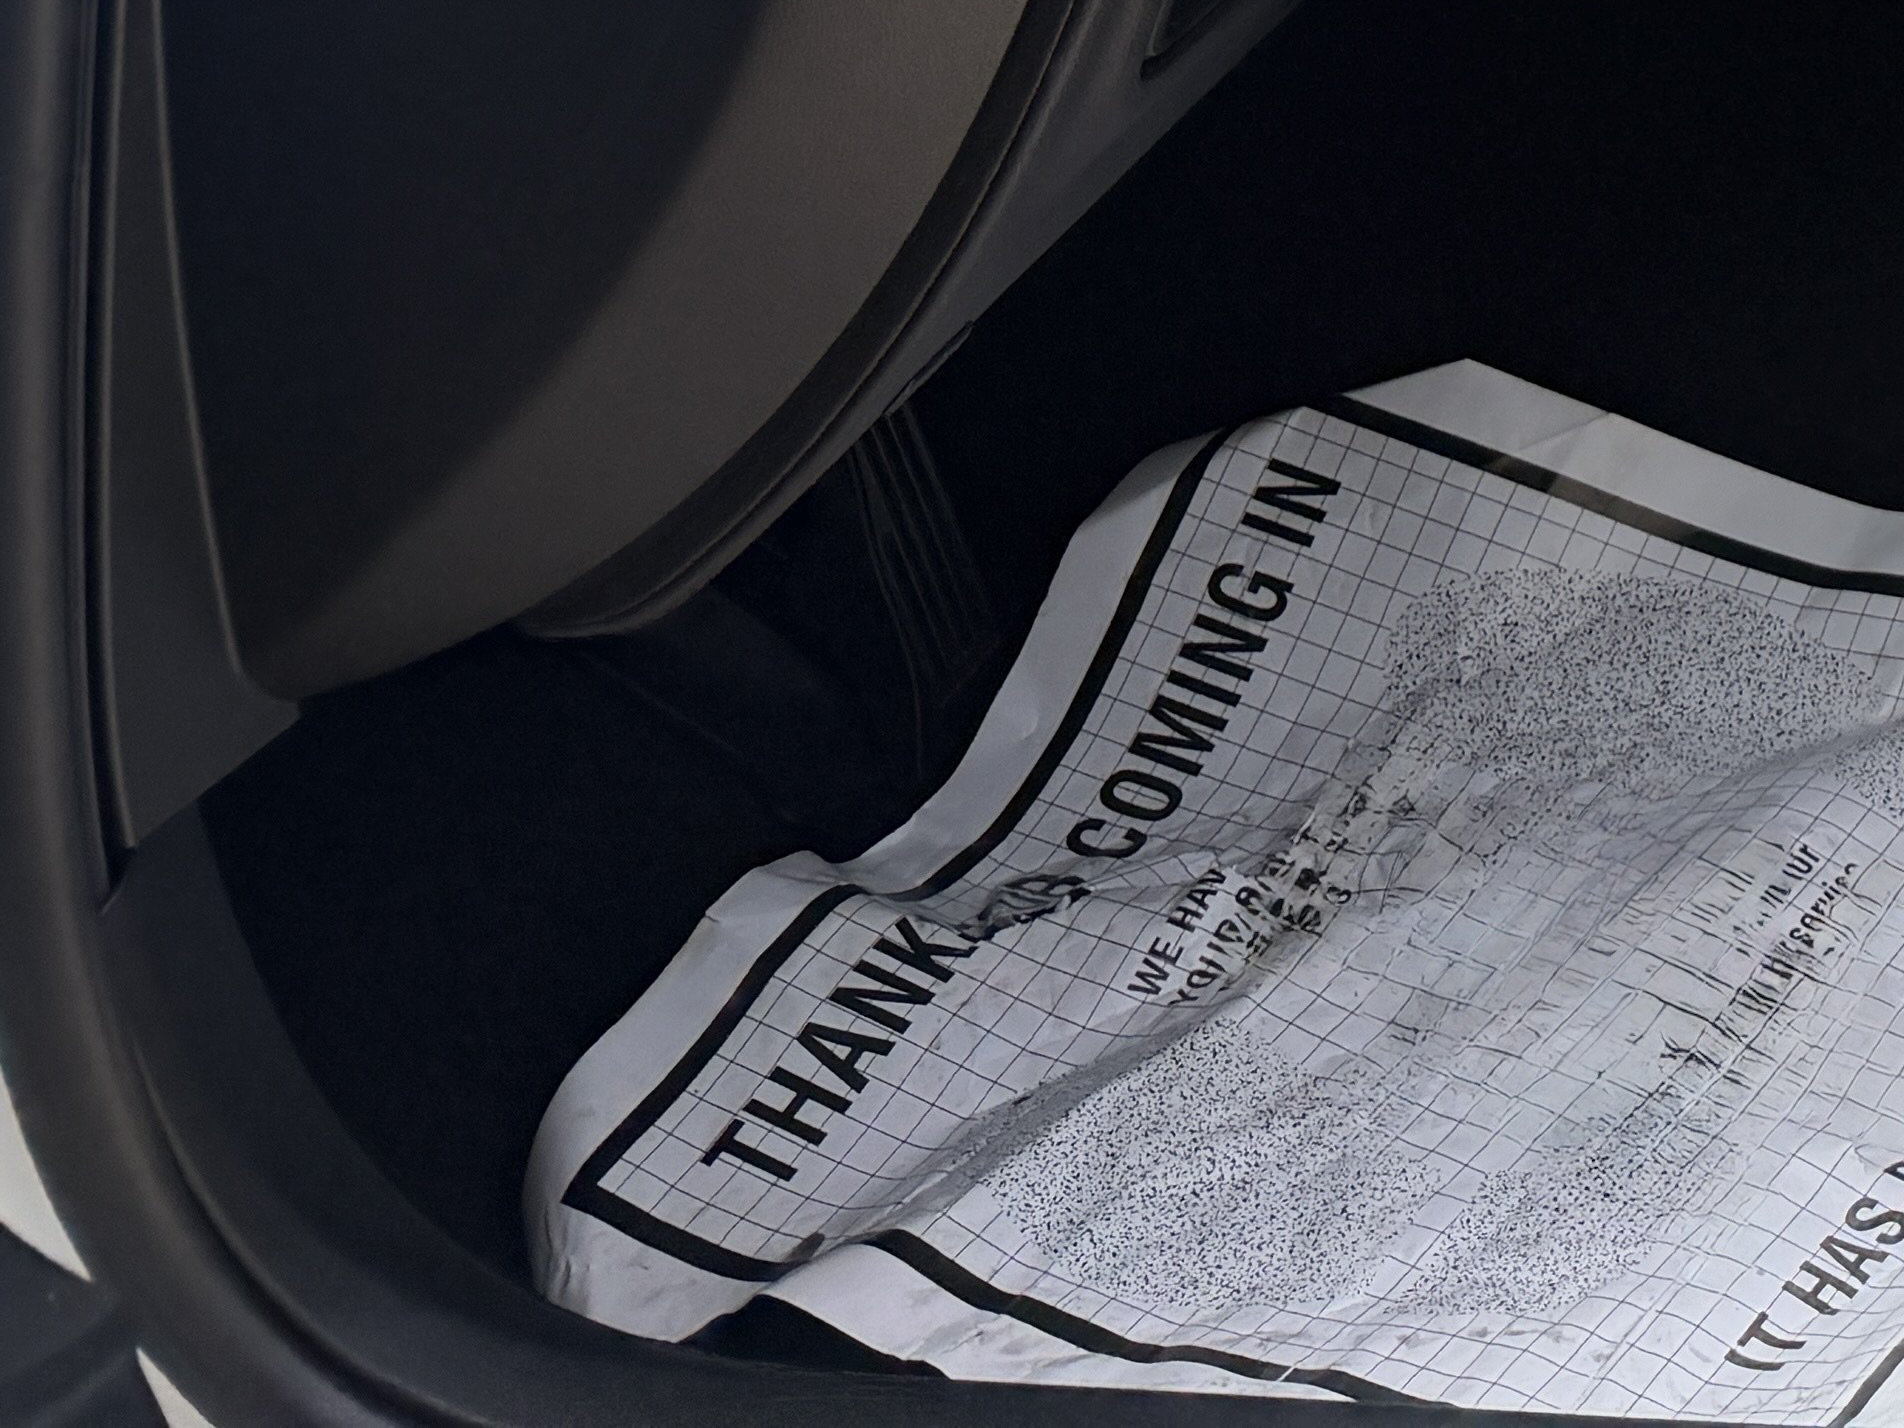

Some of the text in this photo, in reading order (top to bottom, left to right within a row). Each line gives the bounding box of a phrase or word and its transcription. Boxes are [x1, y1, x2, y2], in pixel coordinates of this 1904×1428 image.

[701, 917, 978, 1182] THANK
[1065, 562, 1294, 859] COMING
[1241, 458, 1342, 547] IN
[1127, 936, 1184, 995] WE
[1724, 1311, 1808, 1371] IT
